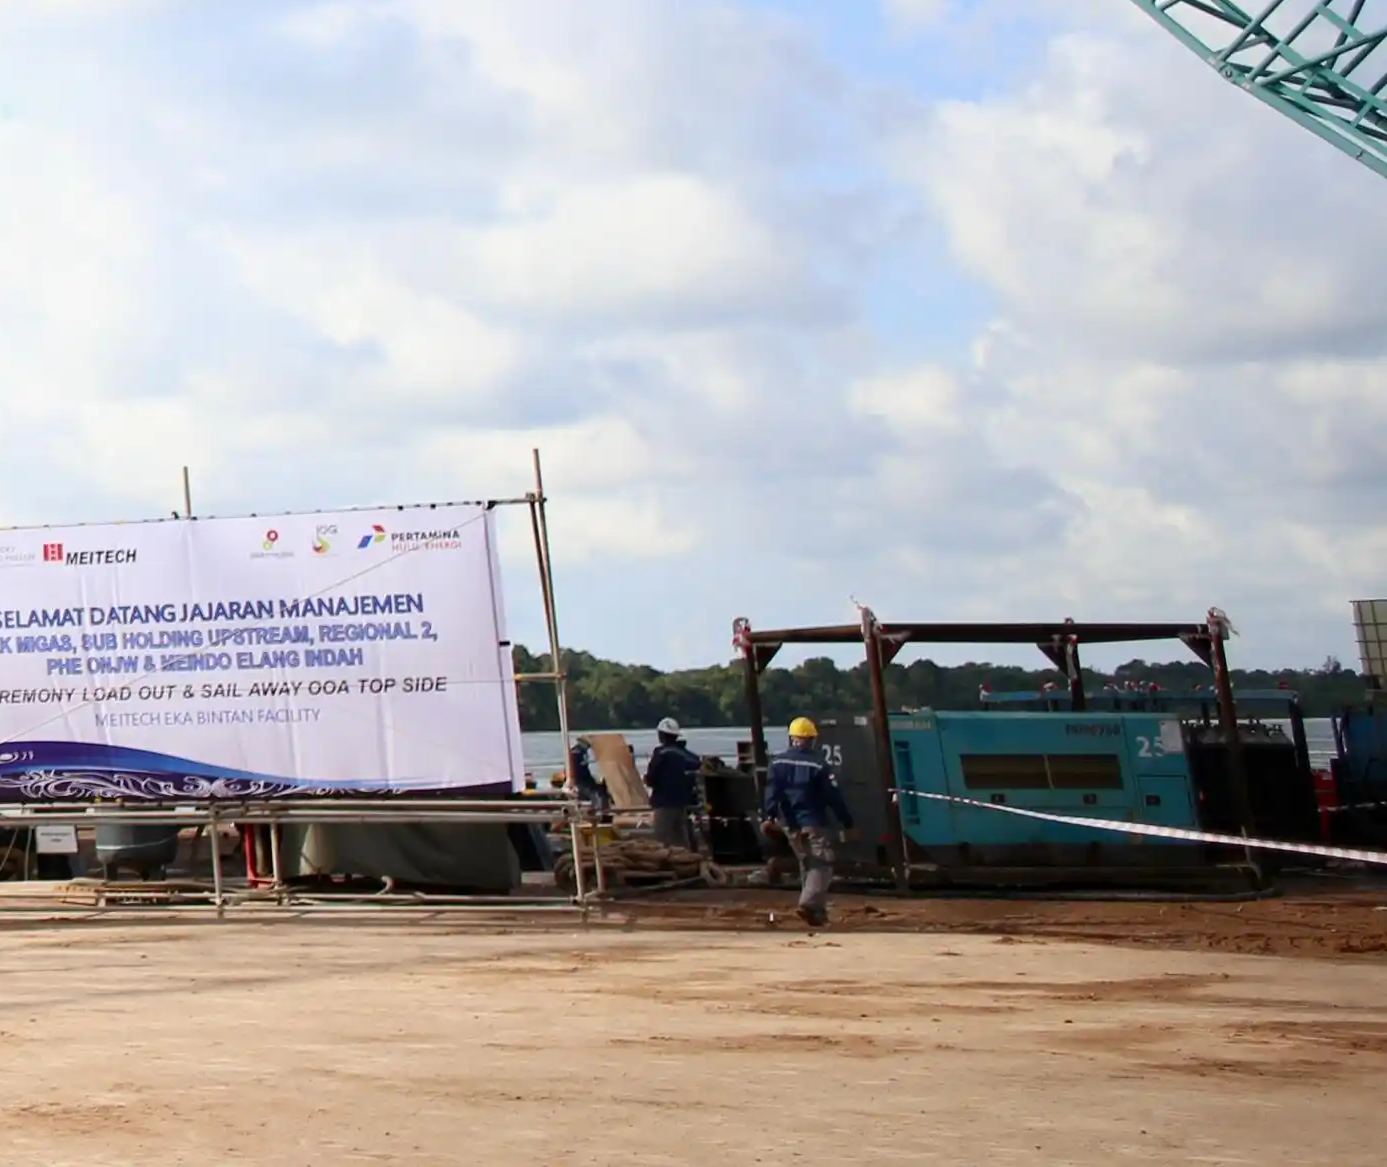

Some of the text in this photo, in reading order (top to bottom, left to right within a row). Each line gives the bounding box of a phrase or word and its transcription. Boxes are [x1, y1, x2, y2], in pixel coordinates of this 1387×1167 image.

[391, 530, 460, 542] PERTAMINA
[65, 549, 137, 566] MEITECH
[90, 604, 176, 625] DATANG
[180, 599, 274, 623] JAJARAN
[279, 593, 423, 619] MANAJEMEN
[81, 632, 117, 651] SUB
[122, 630, 204, 650] HOLDING
[207, 624, 315, 646] UPSTREAM,
[319, 621, 417, 643] REGIONAL
[421, 620, 438, 641] 2,
[46, 656, 83, 675] PHE
[143, 655, 156, 672] &
[161, 651, 231, 672] MEINDO
[236, 649, 300, 670] ELANG
[305, 647, 363, 667] INDAH
[82, 685, 132, 703] LOAD
[138, 685, 177, 701] OUT
[183, 684, 195, 699] &
[200, 682, 242, 699] SAIL
[248, 681, 303, 698] AWAY
[307, 680, 349, 696] OOA
[358, 678, 396, 694] TOP
[402, 676, 447, 693] SIDE
[95, 707, 321, 728] MEITECH EKA BINTAN FACILITY
